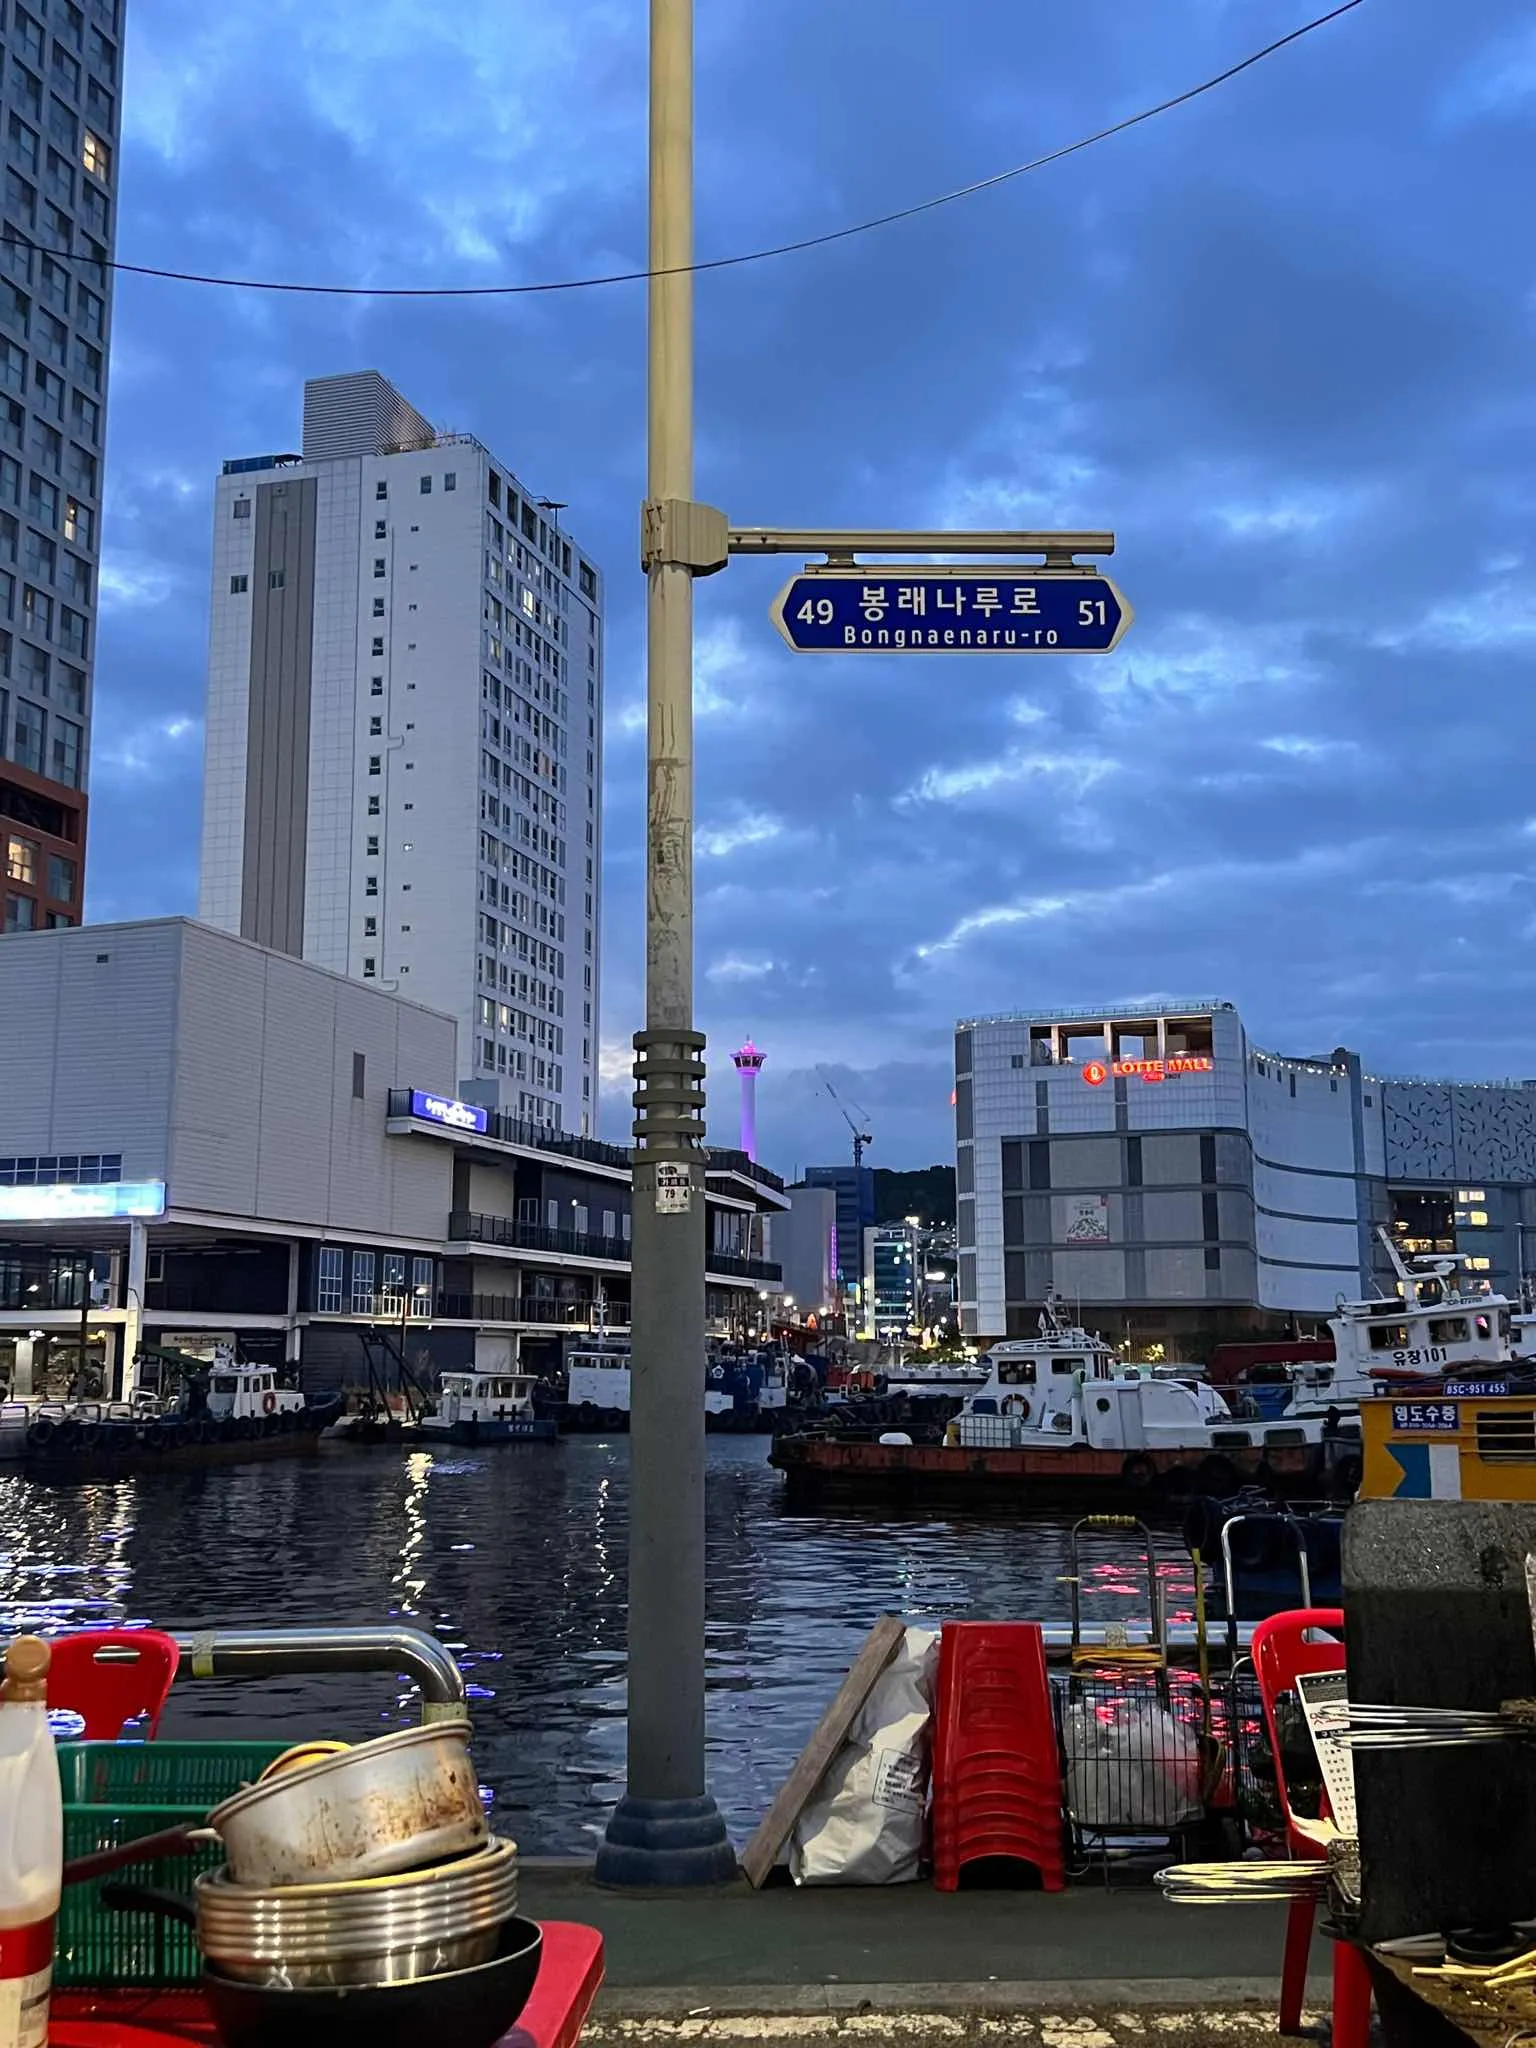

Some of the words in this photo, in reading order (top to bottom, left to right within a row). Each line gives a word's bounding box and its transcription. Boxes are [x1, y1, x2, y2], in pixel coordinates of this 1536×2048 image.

[797, 599, 834, 625] 49
[858, 586, 1041, 622] 봉래나루로
[1078, 600, 1106, 626] 51
[844, 625, 1058, 648] Bongnaenaru-ro
[1112, 1060, 1164, 1075] LOTTE
[1167, 1057, 1213, 1072] MALL
[1394, 1405, 1456, 1422] 영도수중
